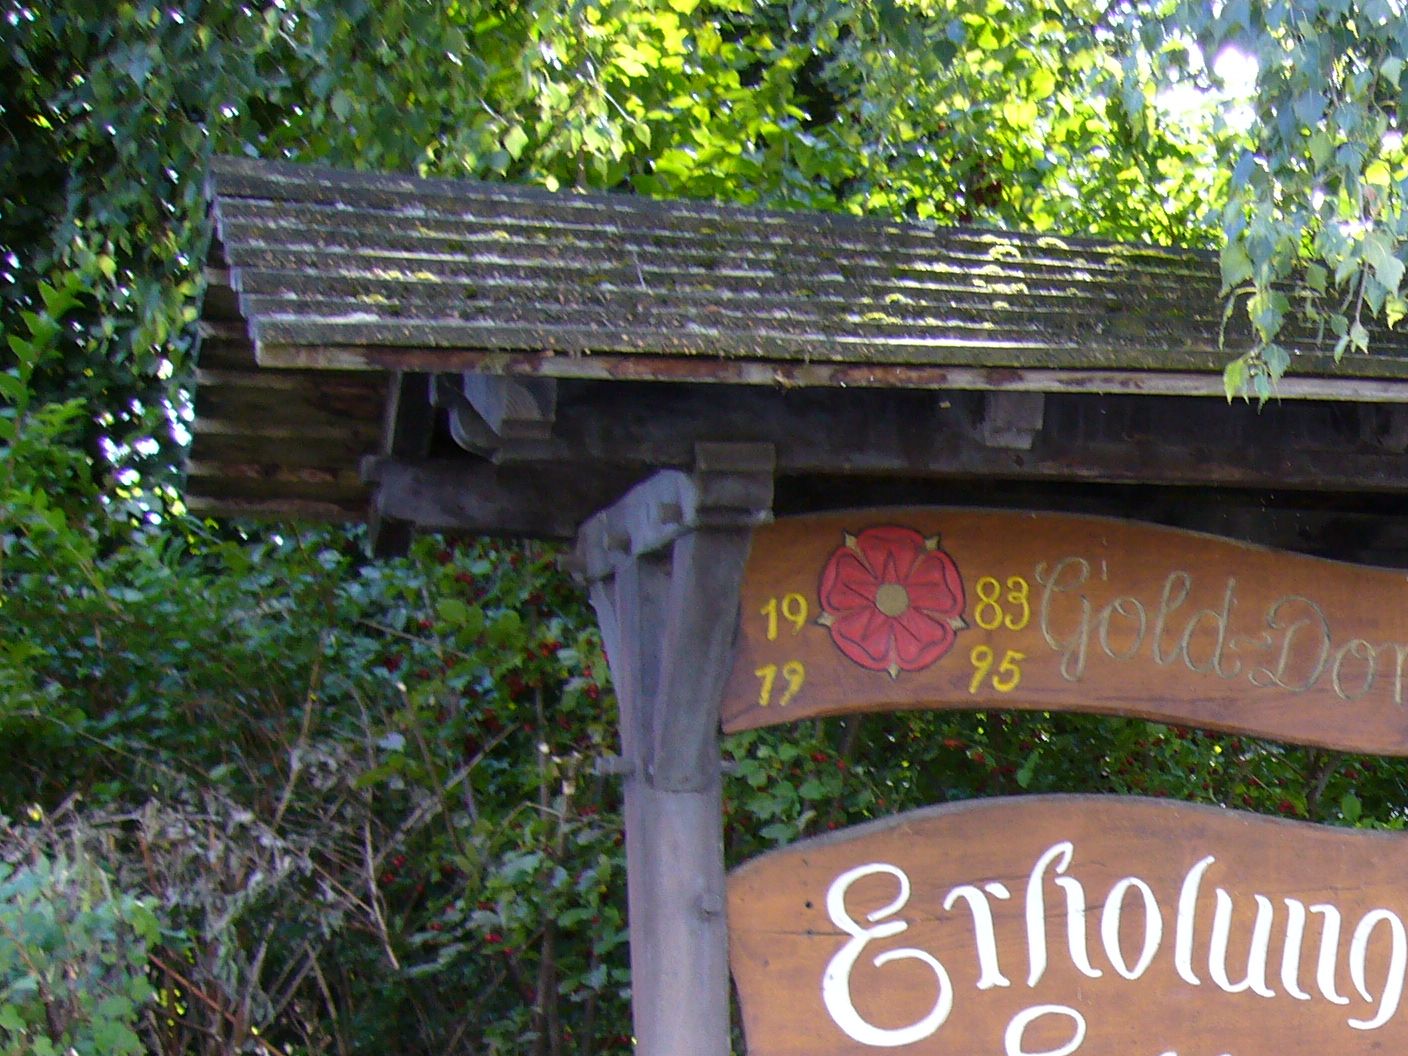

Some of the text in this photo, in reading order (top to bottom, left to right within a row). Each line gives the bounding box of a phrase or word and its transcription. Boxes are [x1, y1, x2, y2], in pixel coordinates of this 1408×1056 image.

[760, 575, 1031, 641] 19 83
[753, 644, 1026, 707] 19 95
